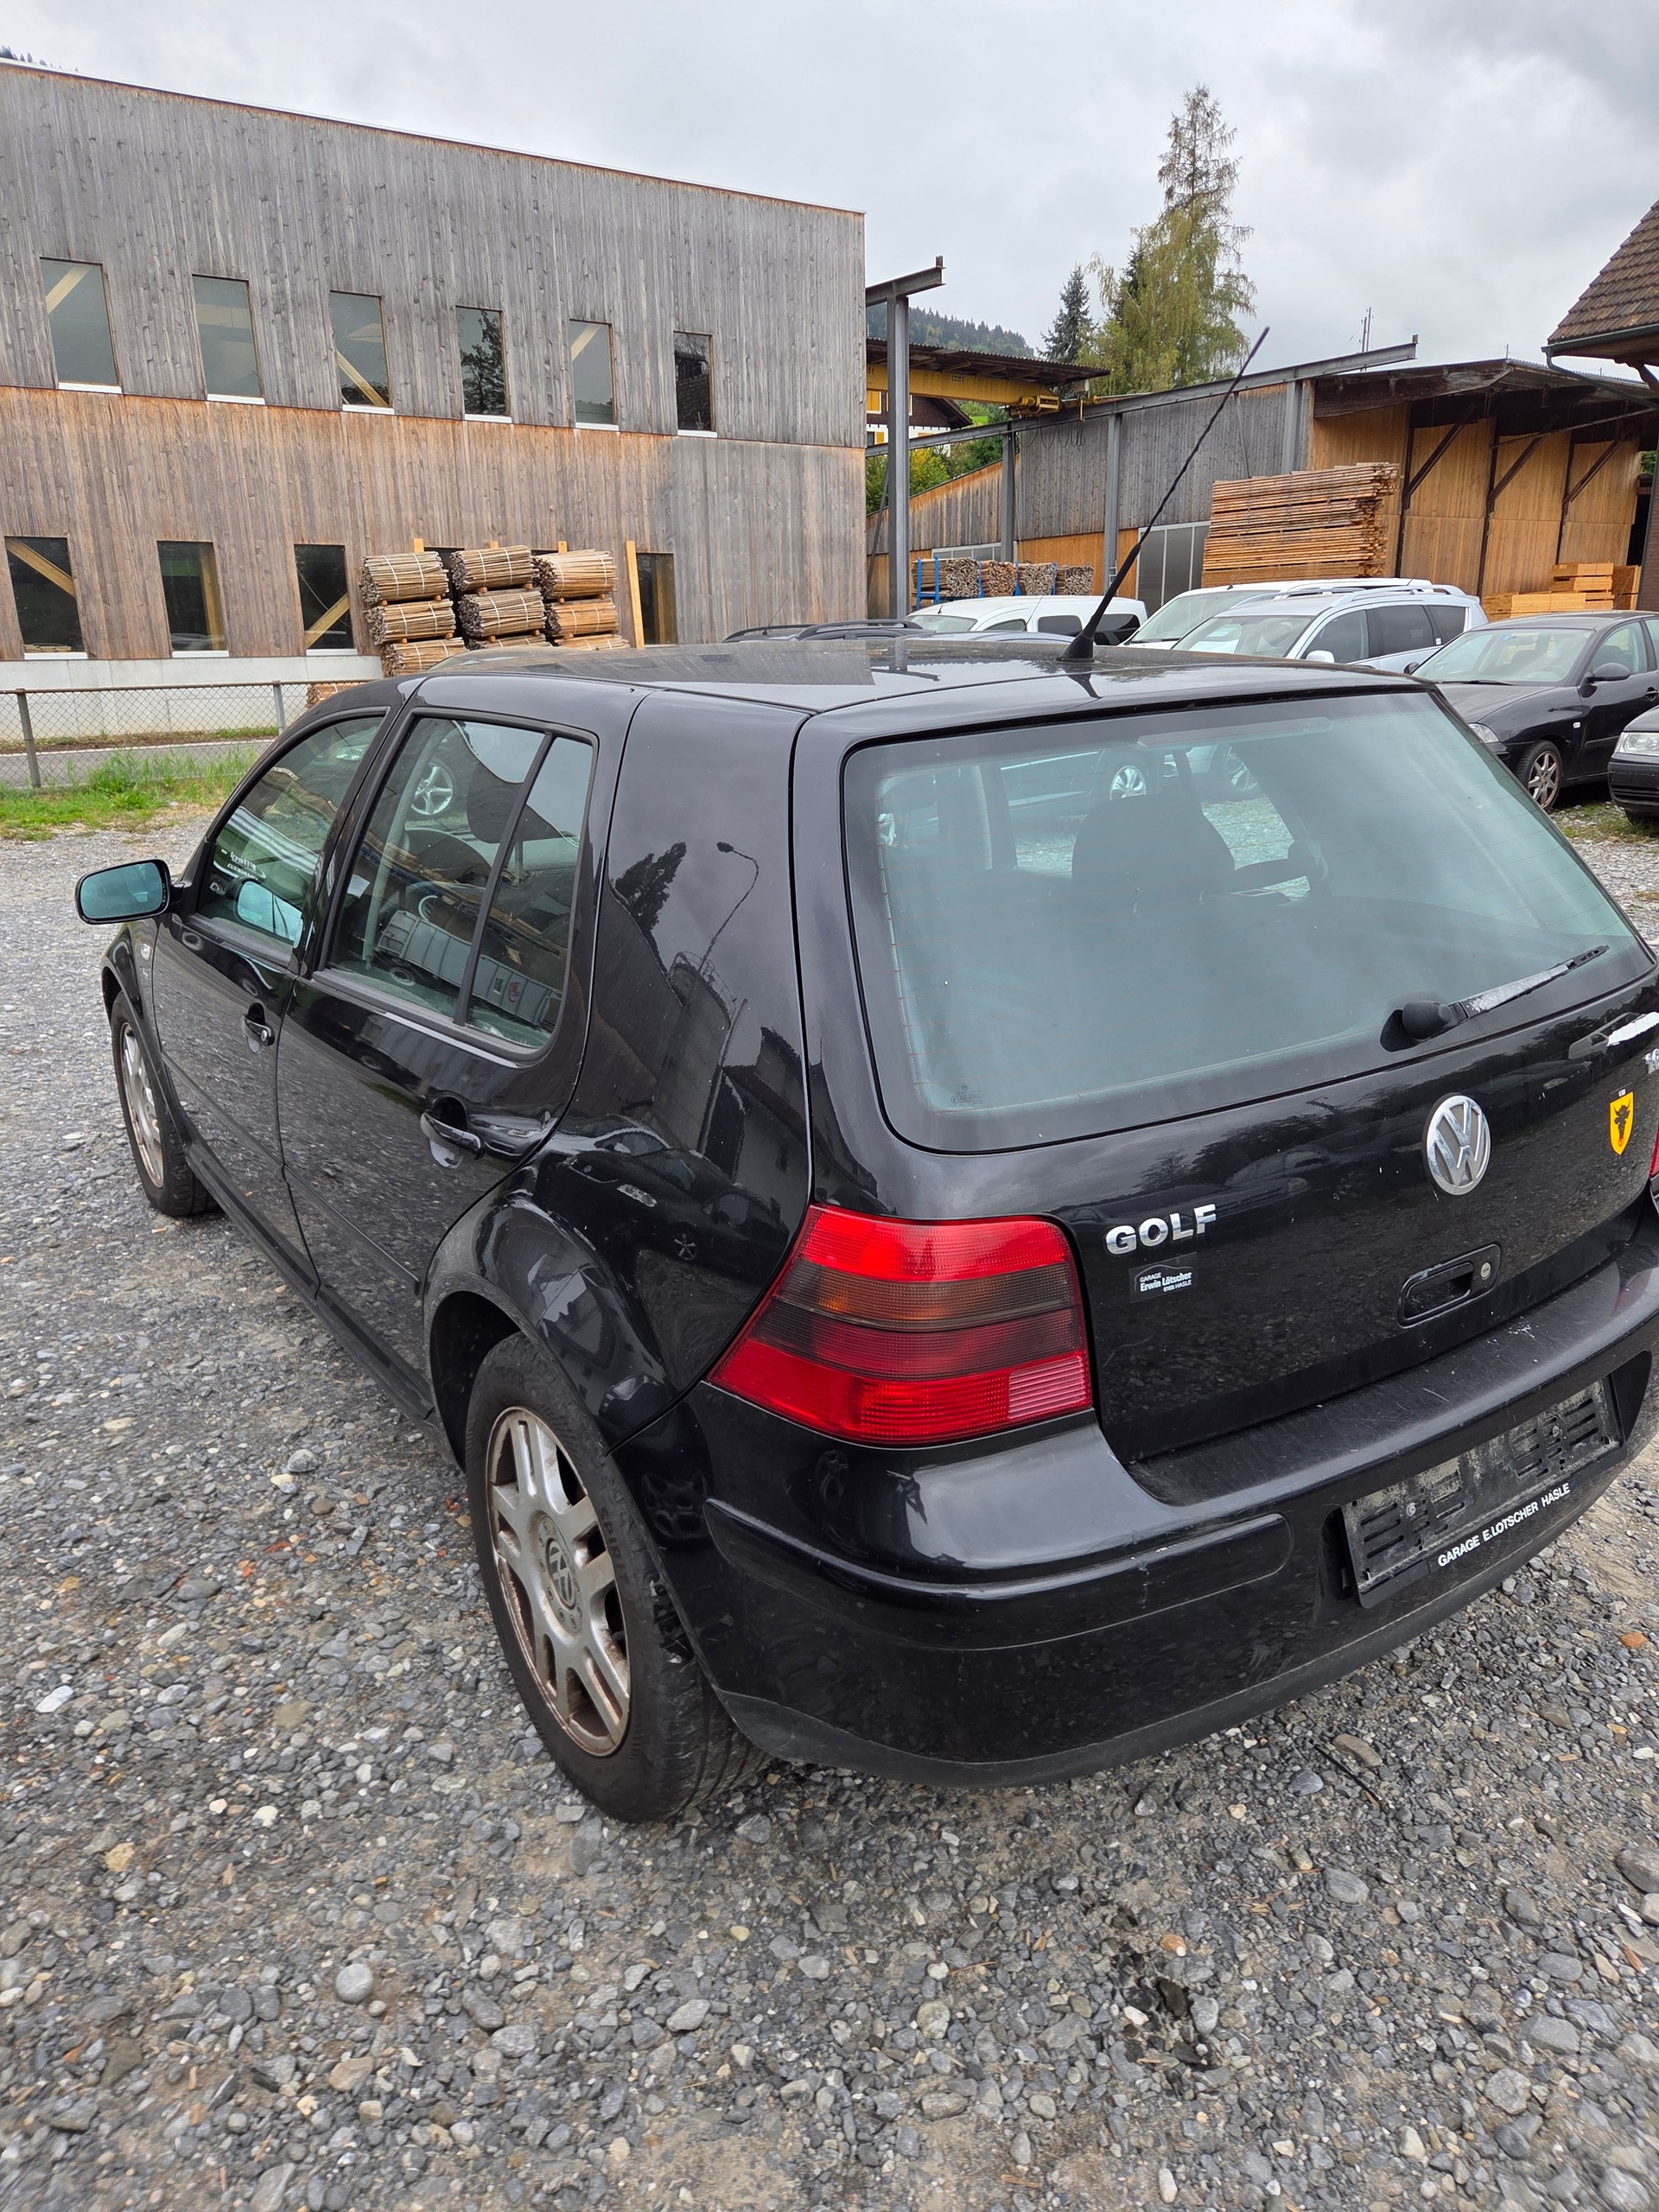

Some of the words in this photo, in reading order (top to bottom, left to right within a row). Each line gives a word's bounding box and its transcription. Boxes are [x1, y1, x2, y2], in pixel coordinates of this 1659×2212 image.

[1105, 1203, 1217, 1255] GOLF
[1140, 1272, 1162, 1283] GARAGE
[1140, 1280, 1162, 1292] Erwin
[1438, 1535, 1481, 1567] GARAGE
[1541, 1483, 1571, 1508] HASLE
